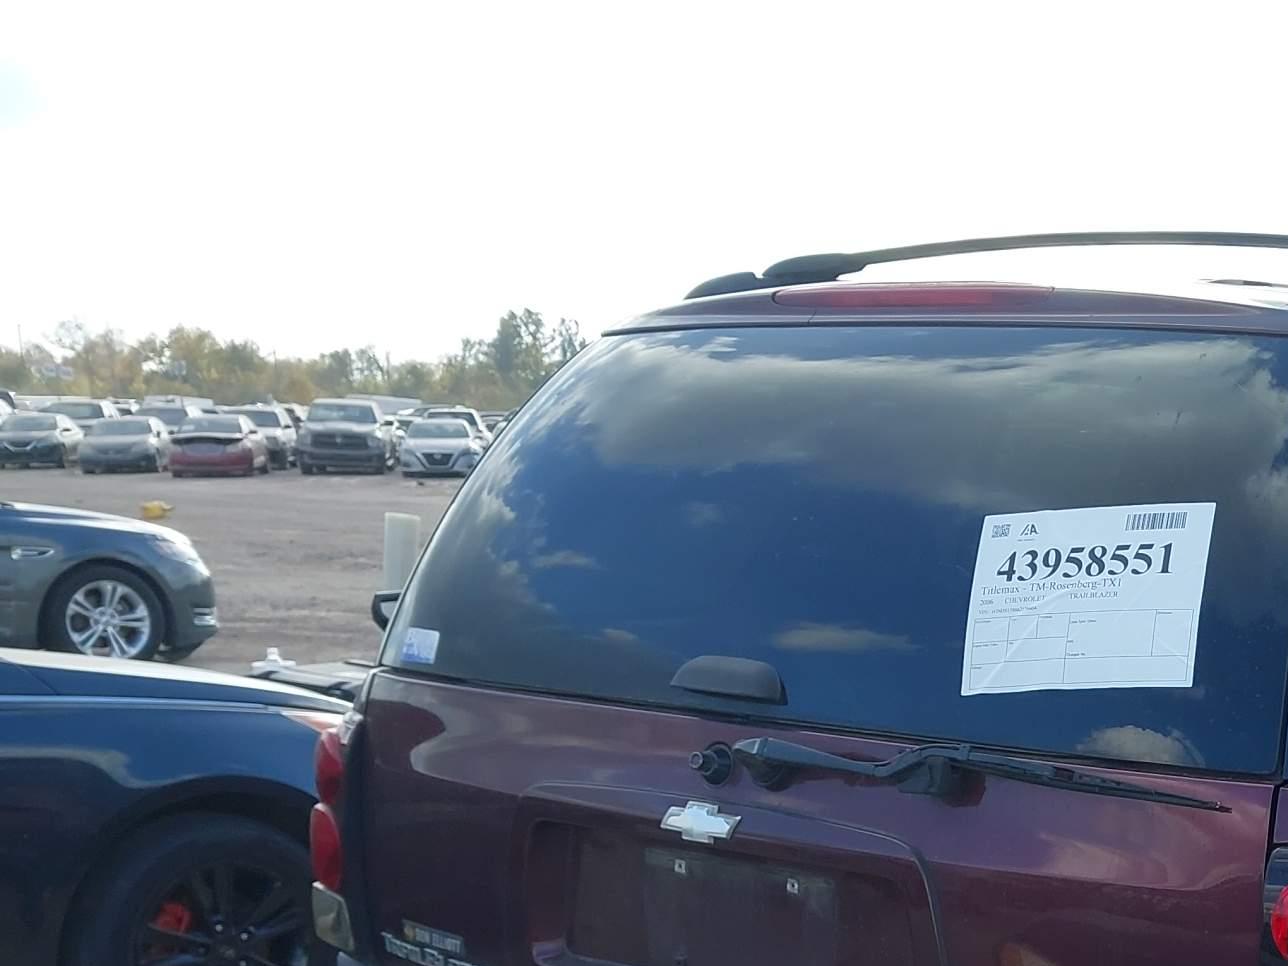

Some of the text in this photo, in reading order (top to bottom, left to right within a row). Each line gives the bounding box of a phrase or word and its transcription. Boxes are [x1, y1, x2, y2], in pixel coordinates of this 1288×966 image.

[996, 541, 1174, 583] 43958551
[981, 585, 1020, 596] Titlemax
[1004, 595, 1046, 604] CHEVROLET
[1069, 591, 1119, 600] TRAILBLAZER
